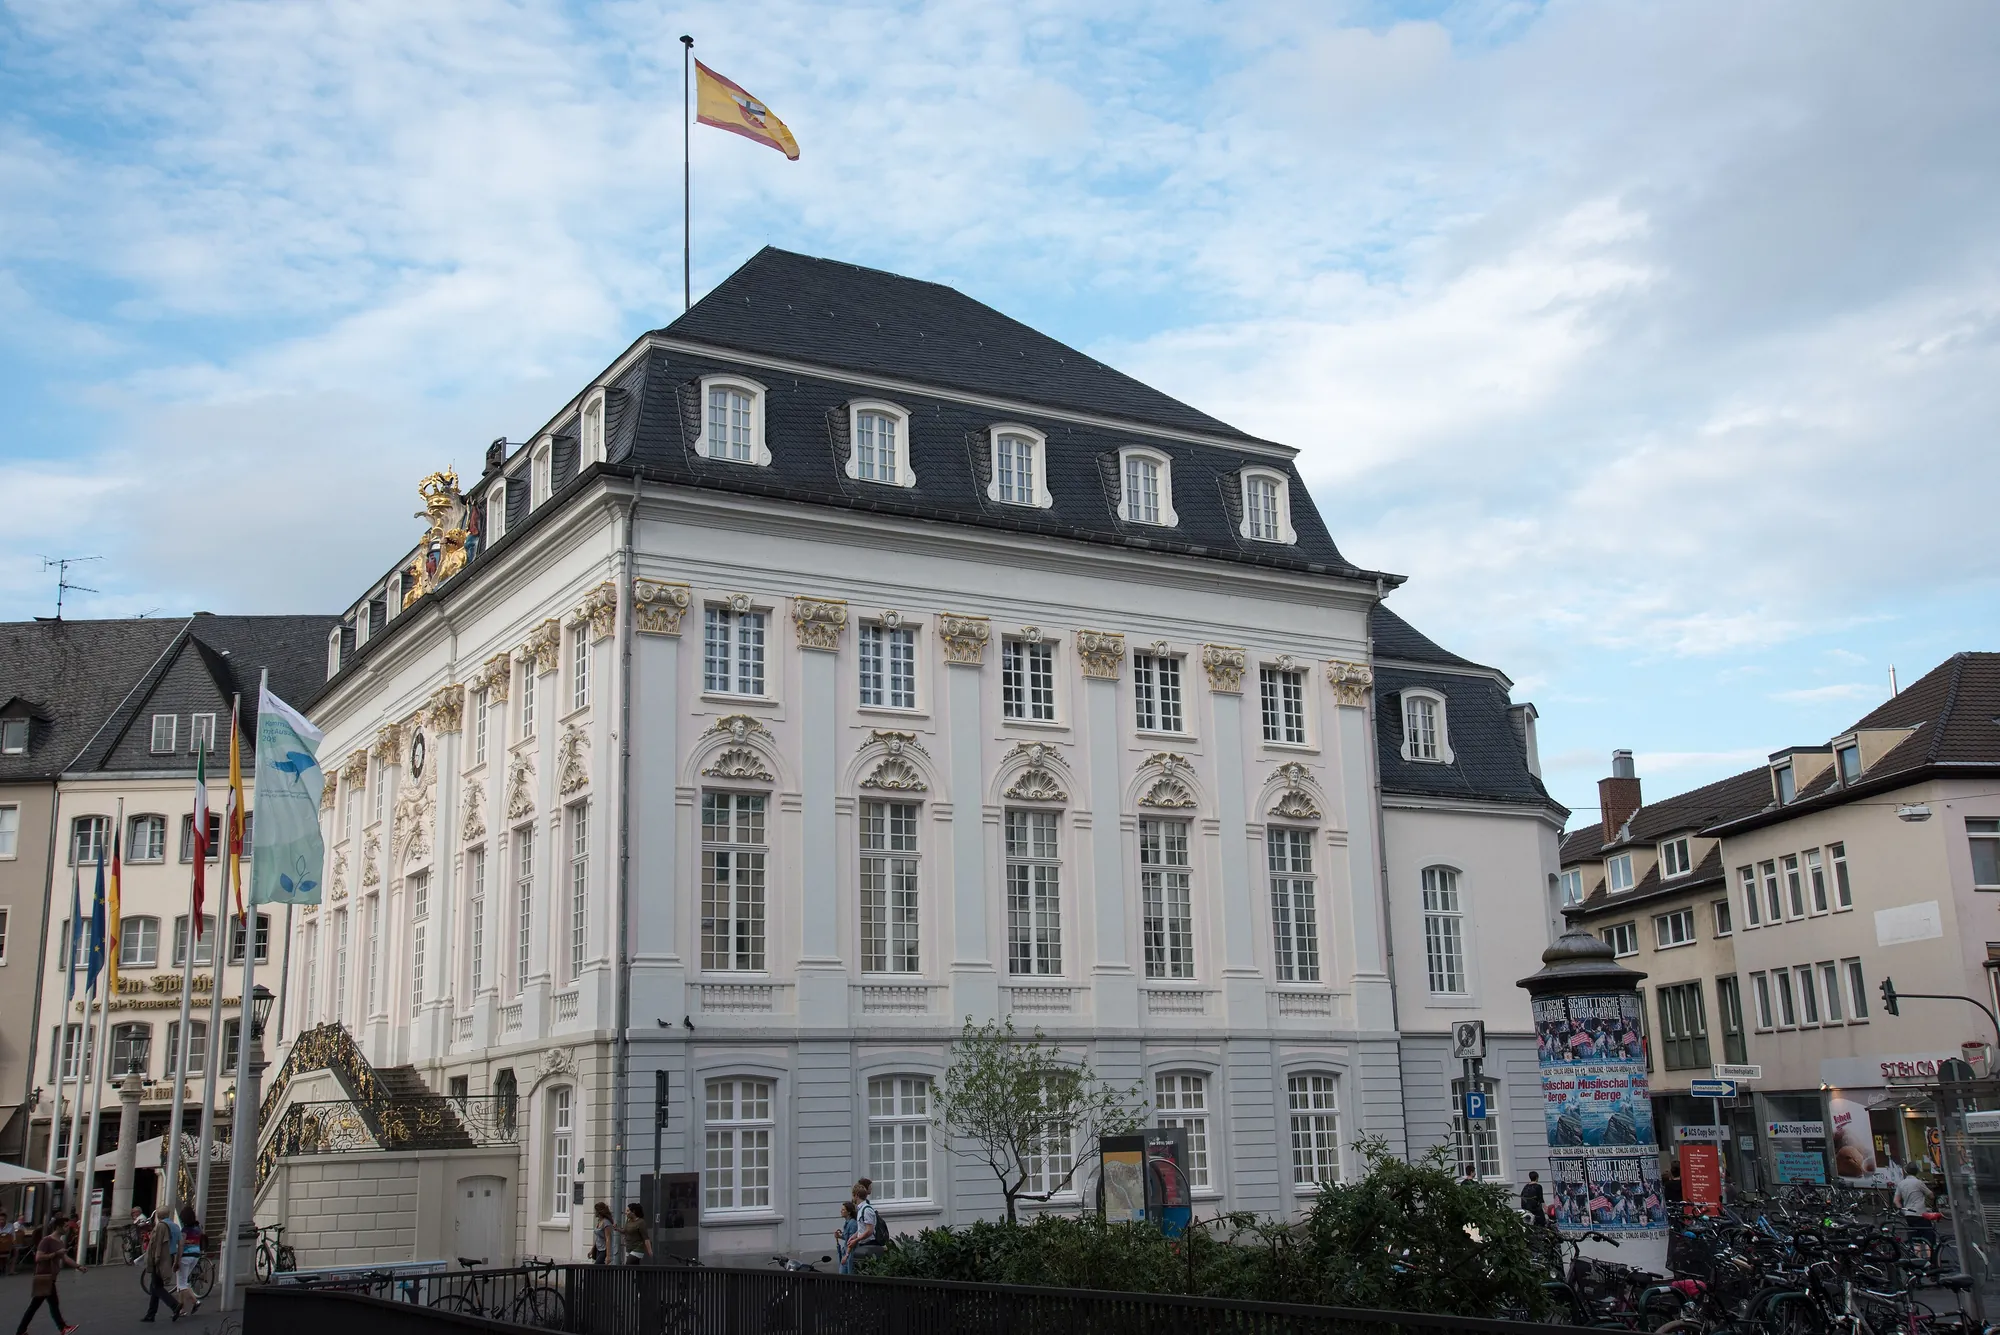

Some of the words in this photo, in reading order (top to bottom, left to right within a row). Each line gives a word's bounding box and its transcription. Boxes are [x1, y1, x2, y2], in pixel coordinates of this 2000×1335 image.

[1461, 1048, 1475, 1056] ZONE
[1724, 1067, 1754, 1076] Bischofsplatz
[1578, 1078, 1629, 1090] Musikschau
[1594, 1090, 1622, 1102] Berge
[1470, 1095, 1482, 1116] P
[1697, 1128, 1708, 1138] Copy
[1779, 1124, 1789, 1134] ACS
[1790, 1124, 1802, 1135] Copy
[1803, 1124, 1822, 1134] Service
[1586, 1158, 1640, 1171] SCHOTTISCHE
